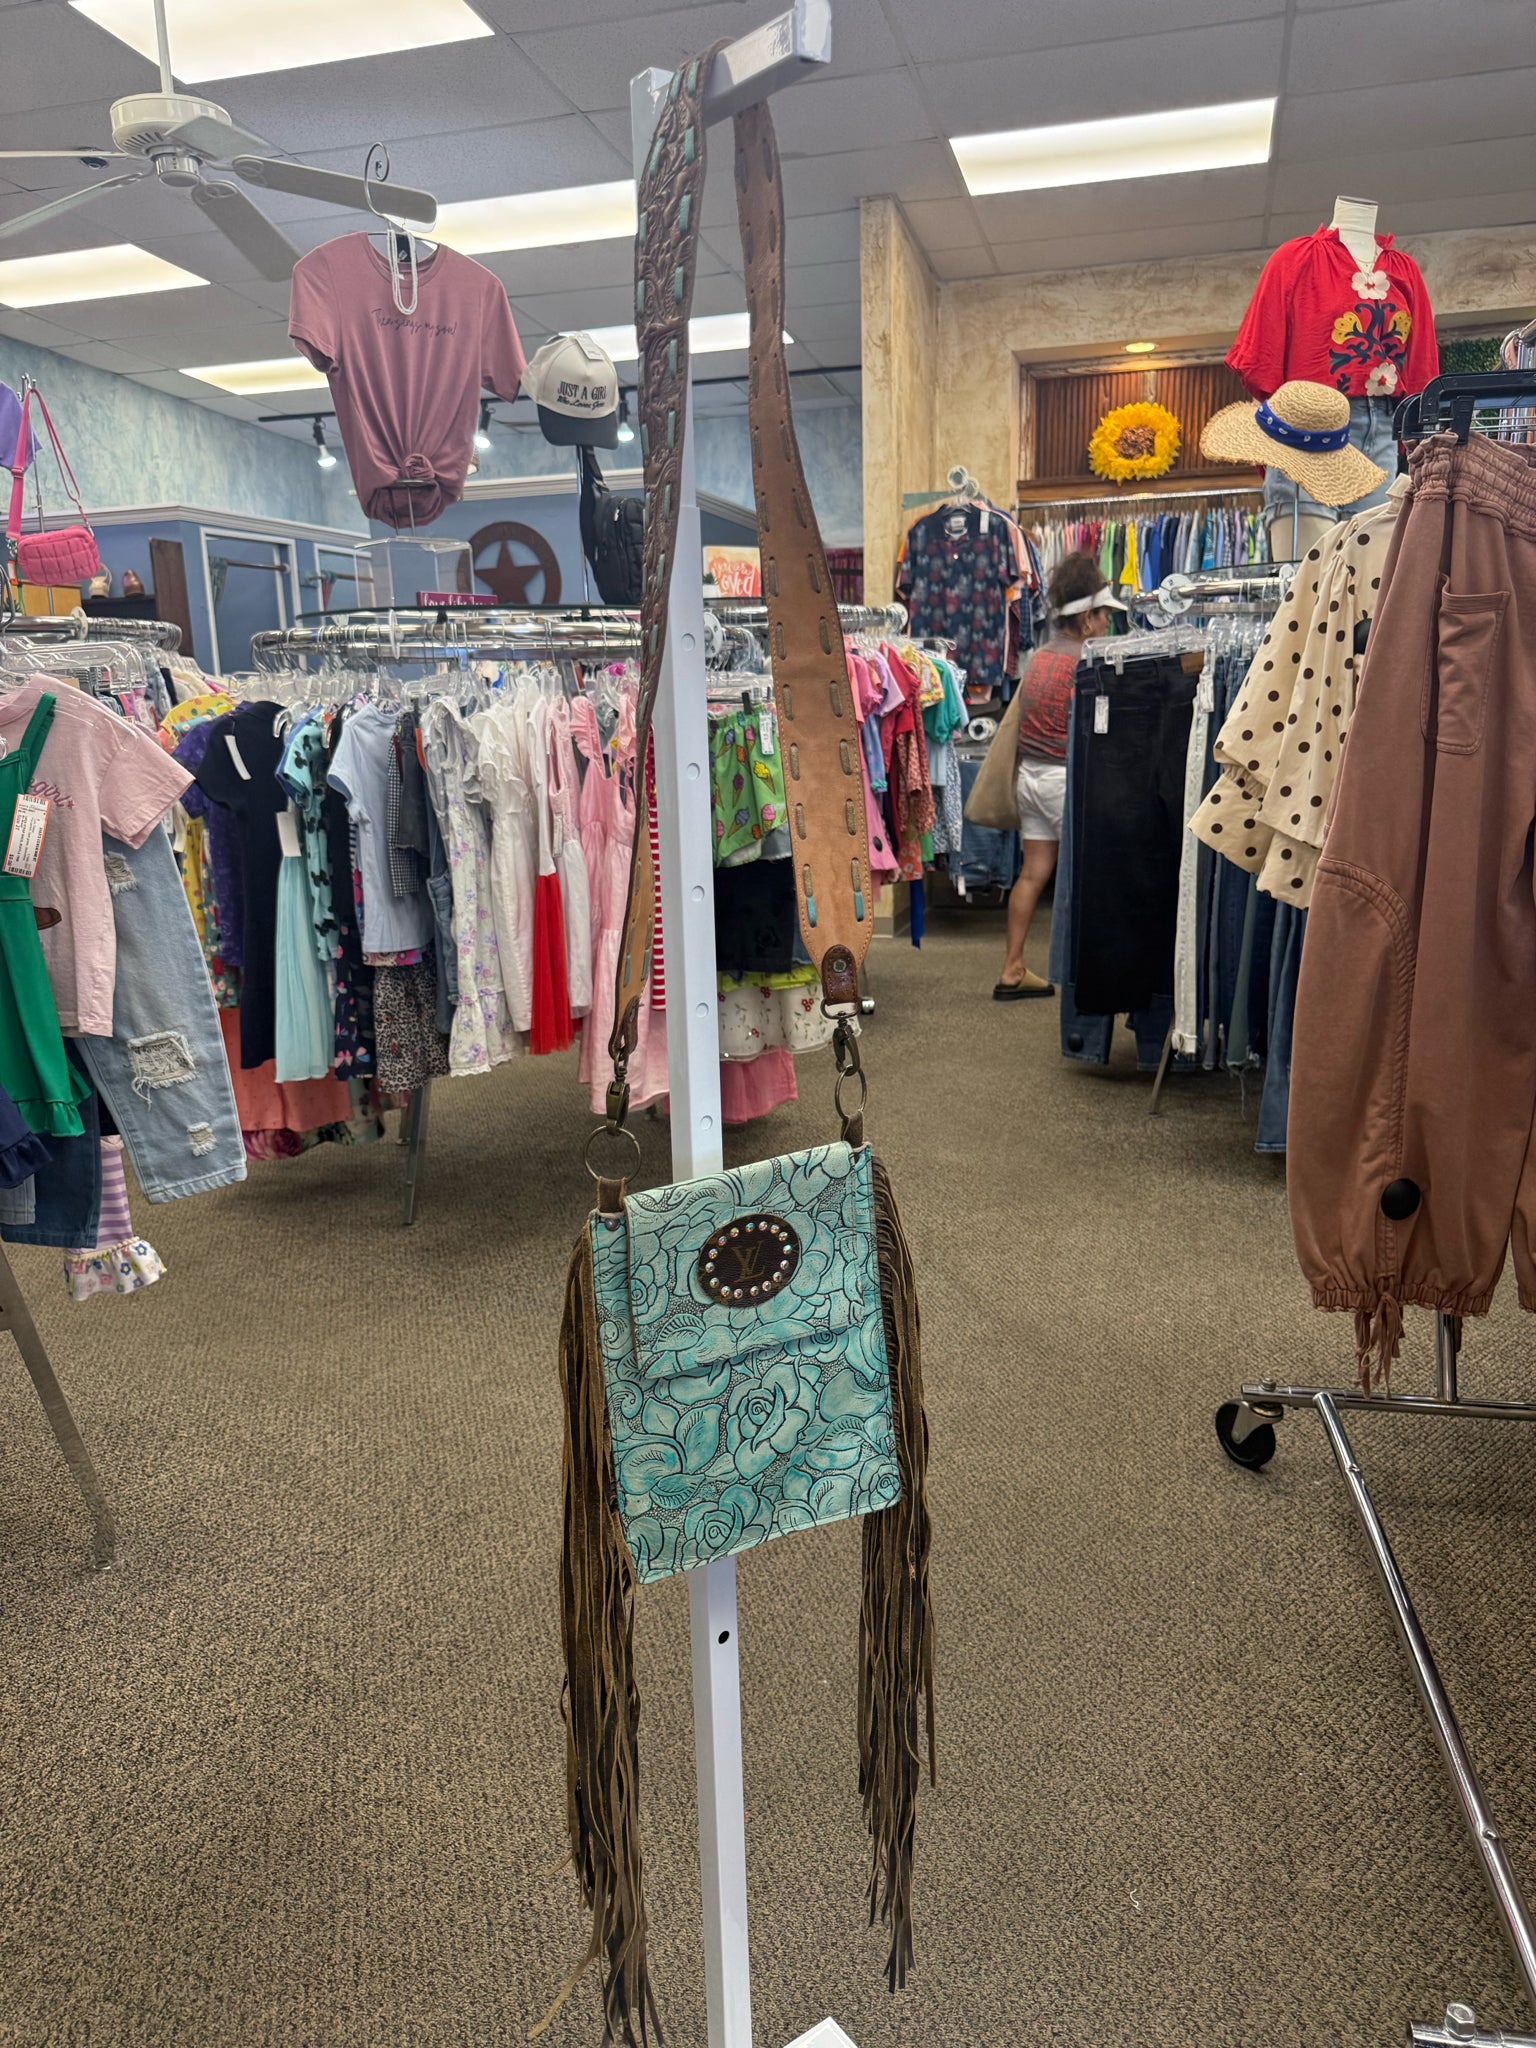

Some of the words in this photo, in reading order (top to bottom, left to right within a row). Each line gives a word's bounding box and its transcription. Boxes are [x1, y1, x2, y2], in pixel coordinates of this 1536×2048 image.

[557, 380, 579, 398] JUST
[580, 386, 588, 400] A
[591, 385, 607, 401] GIRL
